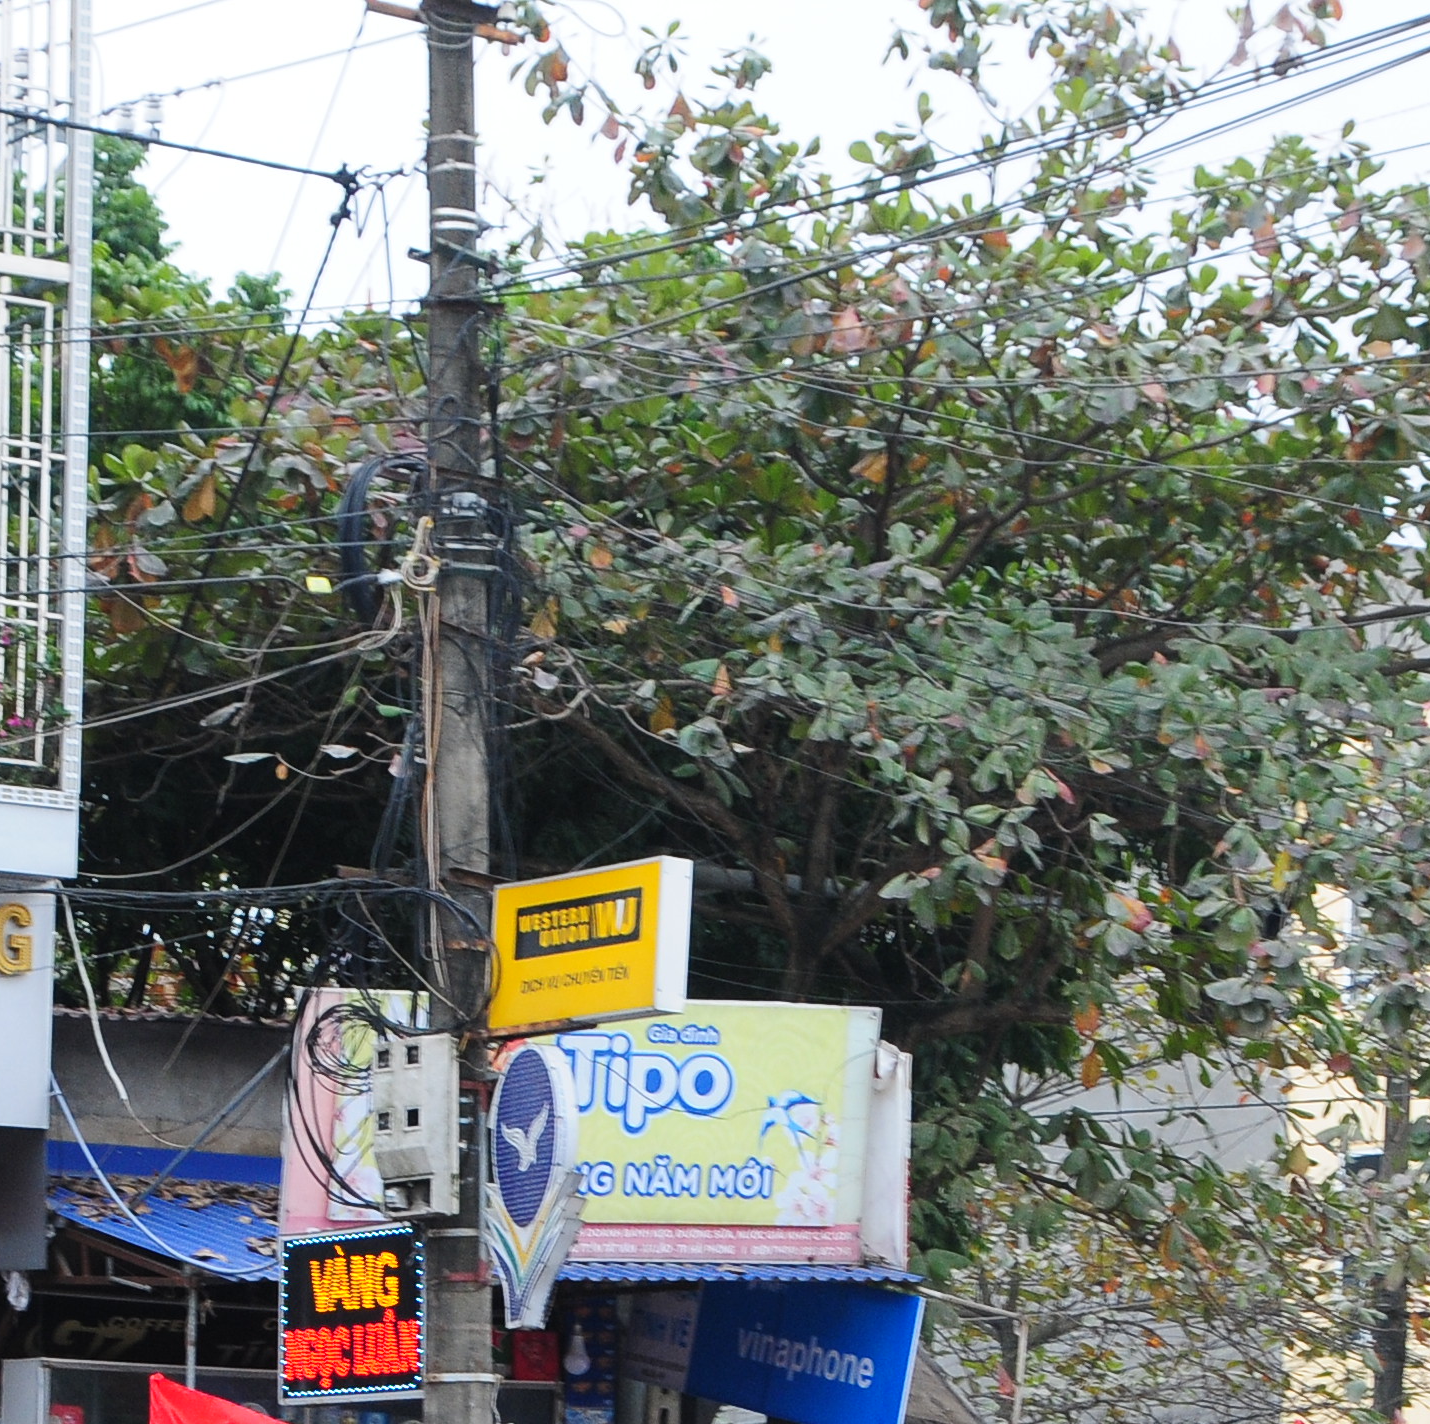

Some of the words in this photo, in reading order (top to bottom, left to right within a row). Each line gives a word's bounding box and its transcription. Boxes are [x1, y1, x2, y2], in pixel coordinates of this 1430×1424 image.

[519, 905, 590, 933] WESTERN
[539, 924, 590, 948] UNION
[647, 1024, 679, 1043] Gia
[557, 1033, 733, 1133] Tipo
[624, 1154, 701, 1197] NĂM
[708, 1157, 774, 1199] MỚI
[309, 1245, 399, 1312] VÀNG
[285, 1326, 351, 1388] NGỌC
[352, 1308, 419, 1375] LUÂN
[737, 1322, 875, 1389] vinaphone
